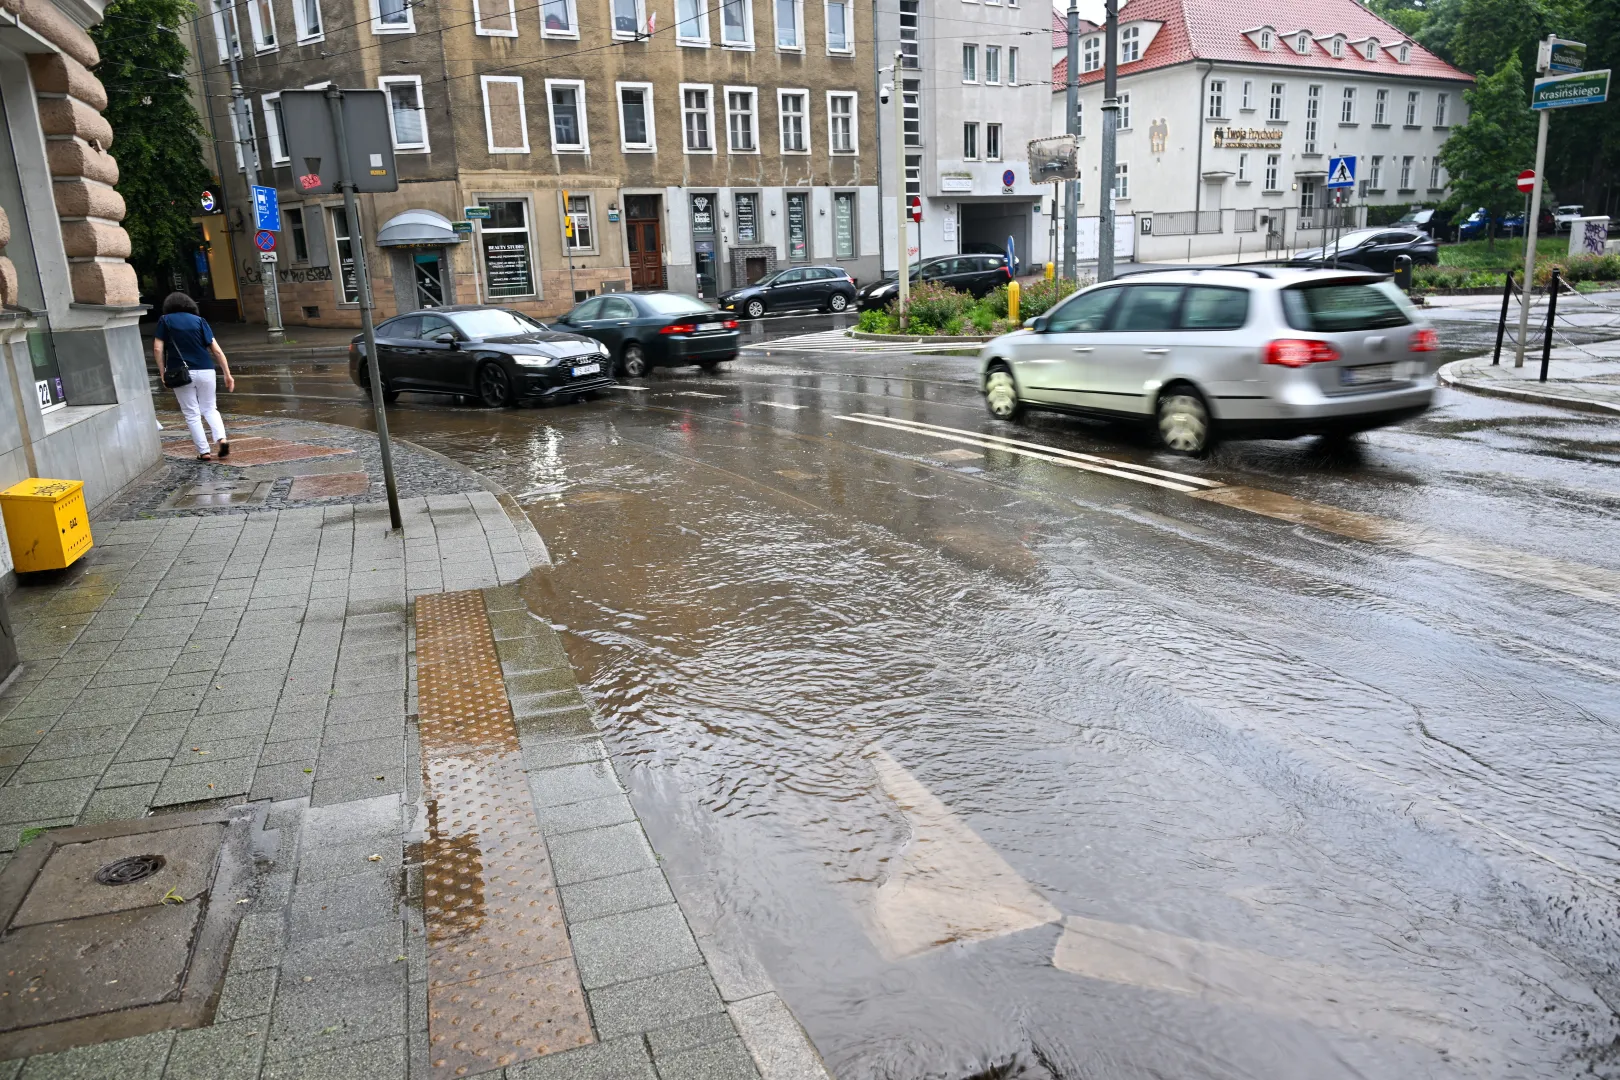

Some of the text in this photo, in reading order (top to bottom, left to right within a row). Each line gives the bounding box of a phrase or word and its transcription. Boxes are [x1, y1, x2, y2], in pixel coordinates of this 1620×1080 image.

[1540, 86, 1600, 99] Krasińskiego
[1227, 127, 1246, 140] Twoja
[1142, 218, 1151, 231] 19
[38, 383, 50, 405] 22
